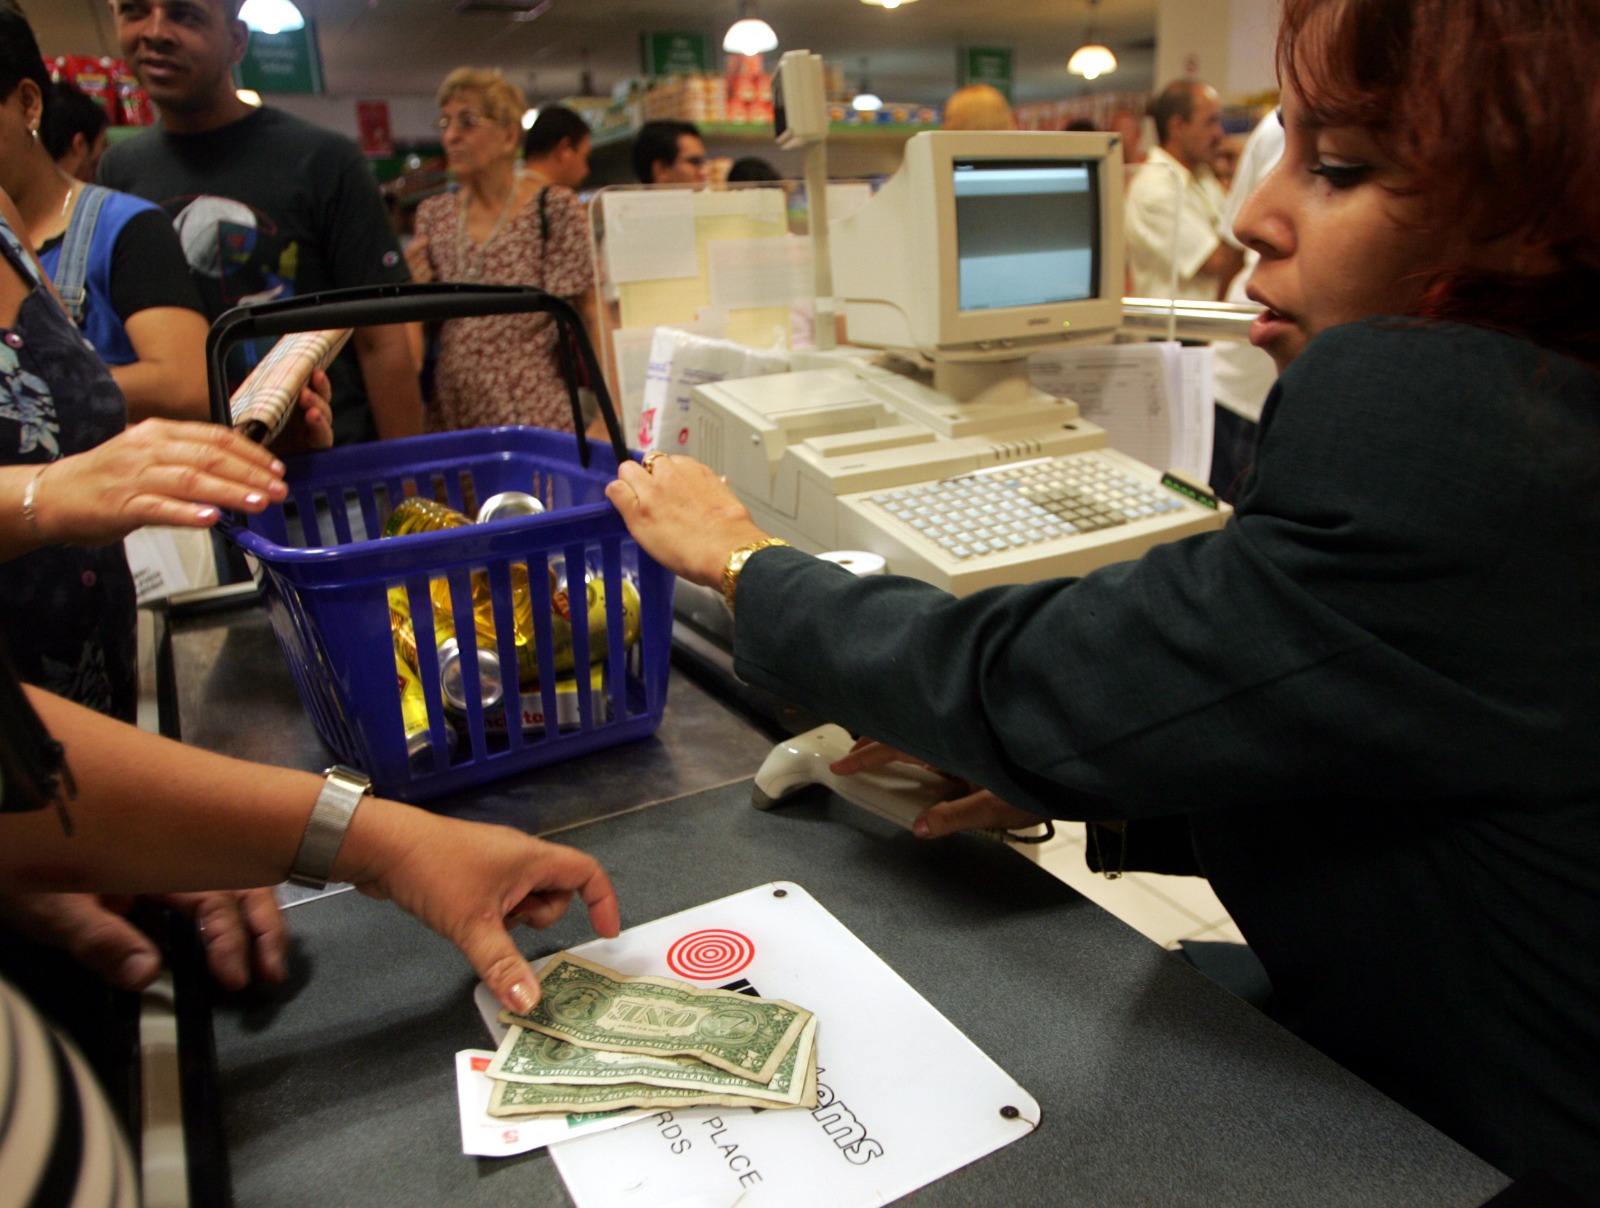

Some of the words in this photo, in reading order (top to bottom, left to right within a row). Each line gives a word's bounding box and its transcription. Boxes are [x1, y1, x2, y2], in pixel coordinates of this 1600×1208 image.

[607, 999, 698, 1029] ONE
[540, 1068, 598, 1077] AMERICA
[601, 1069, 616, 1077] OF
[617, 1067, 669, 1078] STATES
[669, 1071, 719, 1083] UNITED
[719, 1076, 749, 1087] THE
[811, 1067, 884, 1165] ems
[652, 1111, 692, 1154] RDS
[702, 1116, 763, 1189] PLACE
